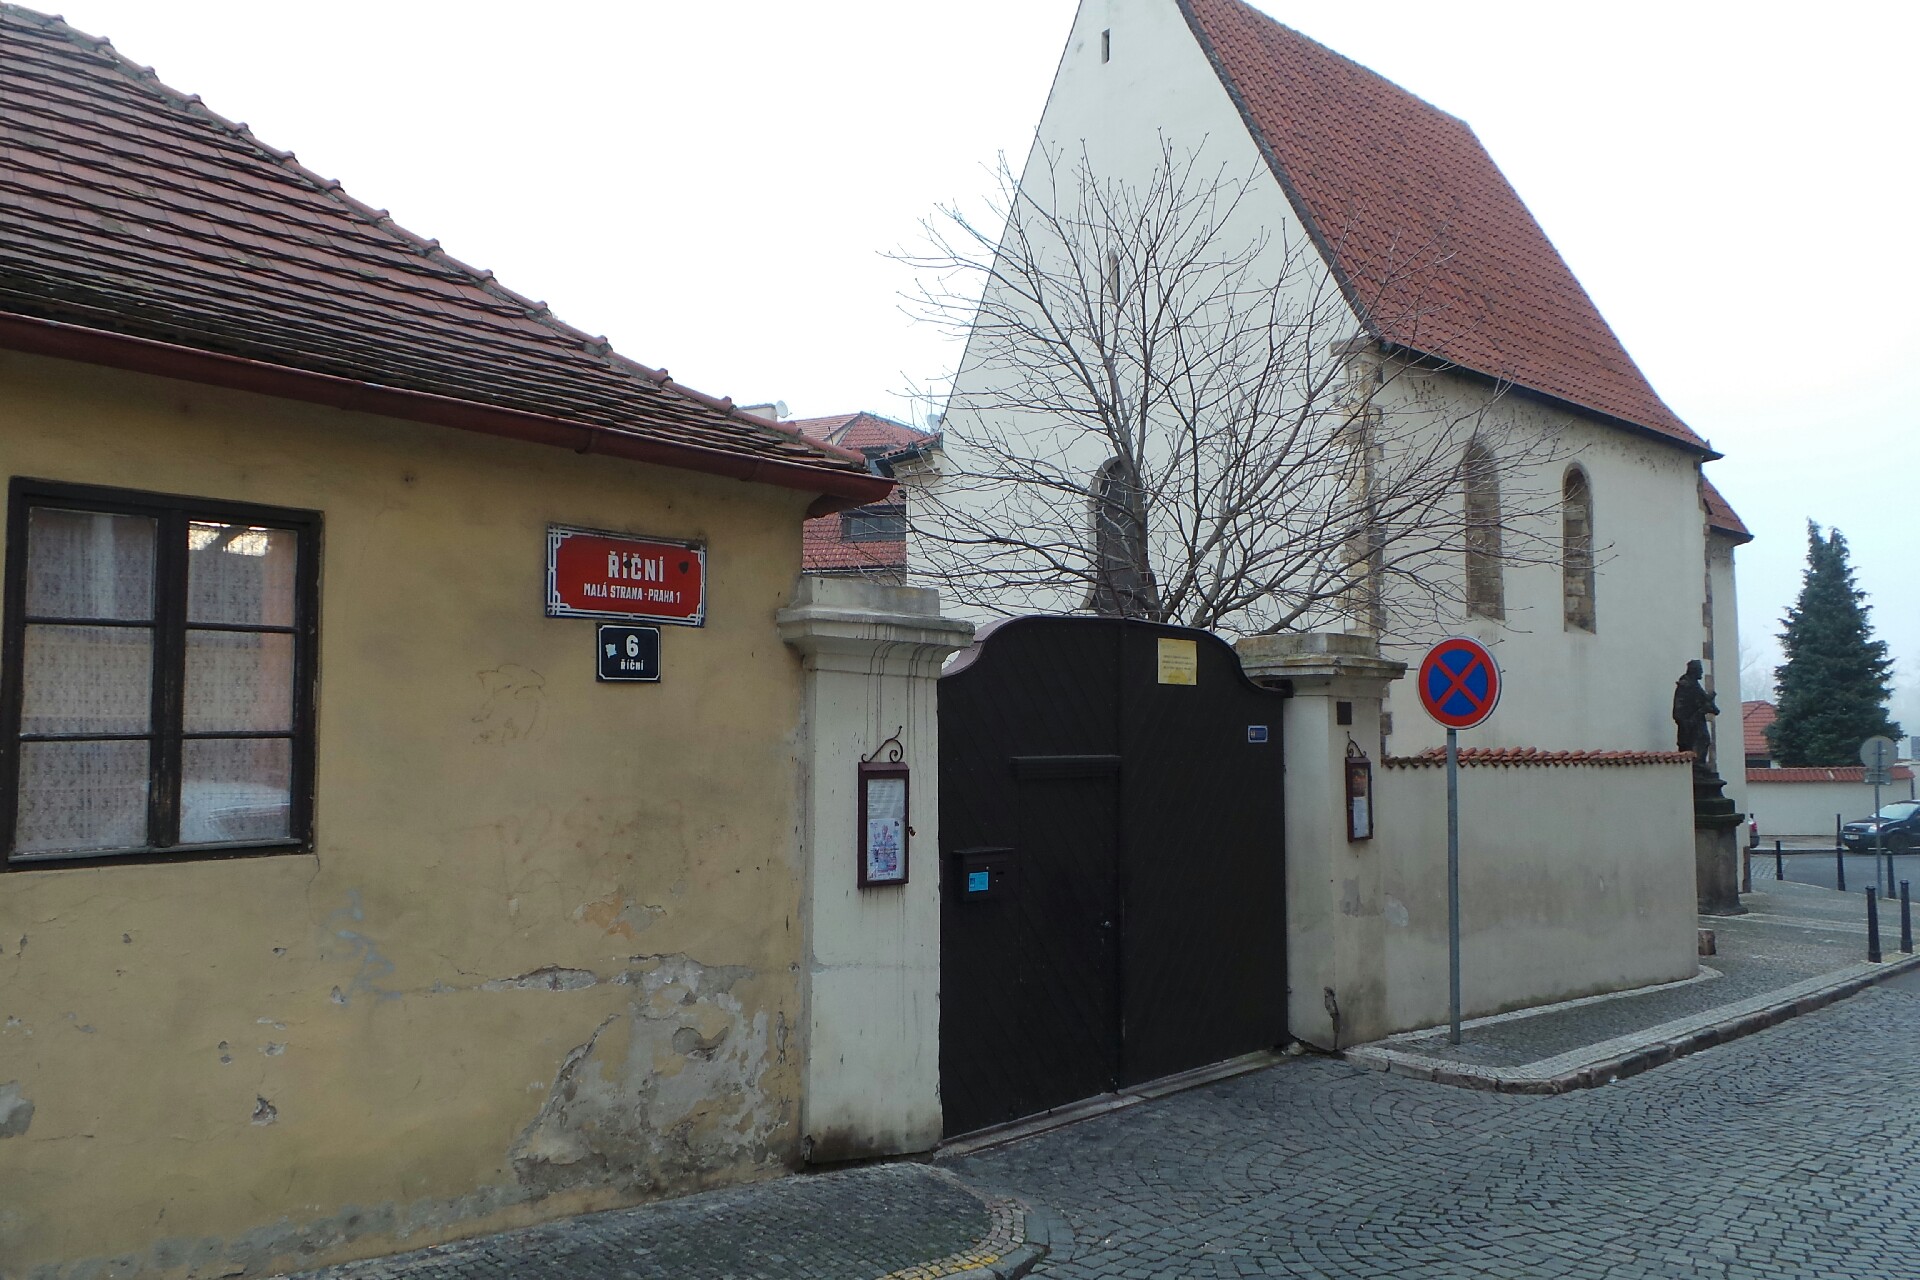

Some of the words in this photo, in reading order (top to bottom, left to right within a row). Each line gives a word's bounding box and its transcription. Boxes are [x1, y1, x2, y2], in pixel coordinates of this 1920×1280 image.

[608, 550, 664, 582] ŘÍČNÍ
[583, 582, 608, 598] MALÁ
[610, 585, 643, 601] STRANA
[648, 588, 674, 604] PRAHA
[676, 591, 681, 604] 1
[626, 634, 639, 657] 6
